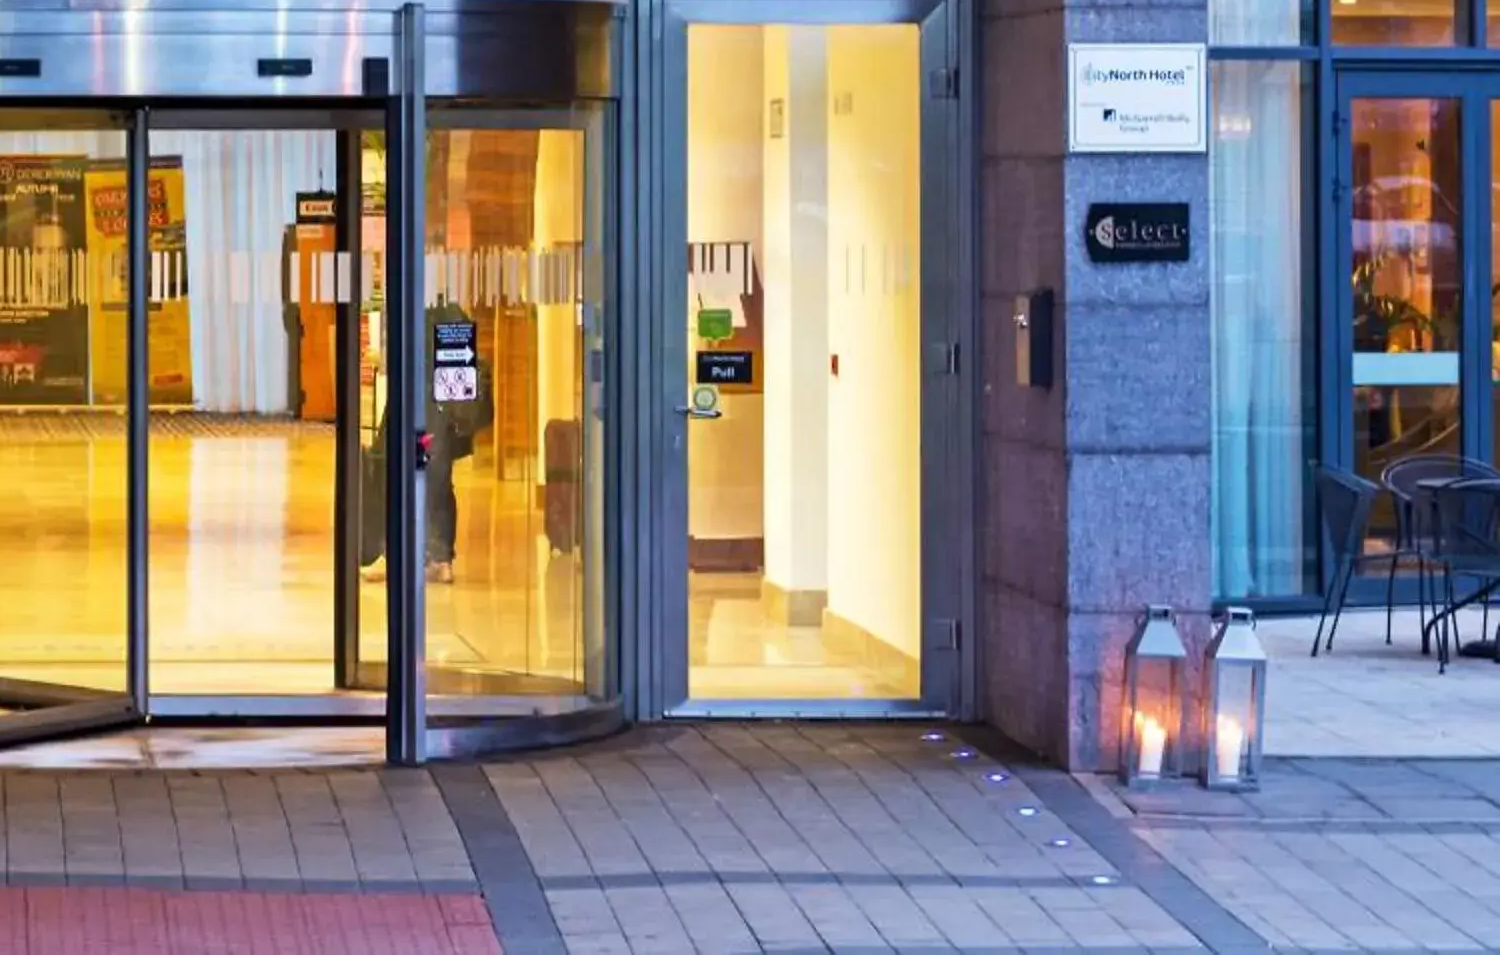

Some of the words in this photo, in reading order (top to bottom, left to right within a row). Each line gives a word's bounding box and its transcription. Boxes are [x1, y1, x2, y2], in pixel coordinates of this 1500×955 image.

[1149, 69, 1185, 82] Hotel
[1096, 217, 1181, 245] Select
[711, 366, 735, 378] Pull
